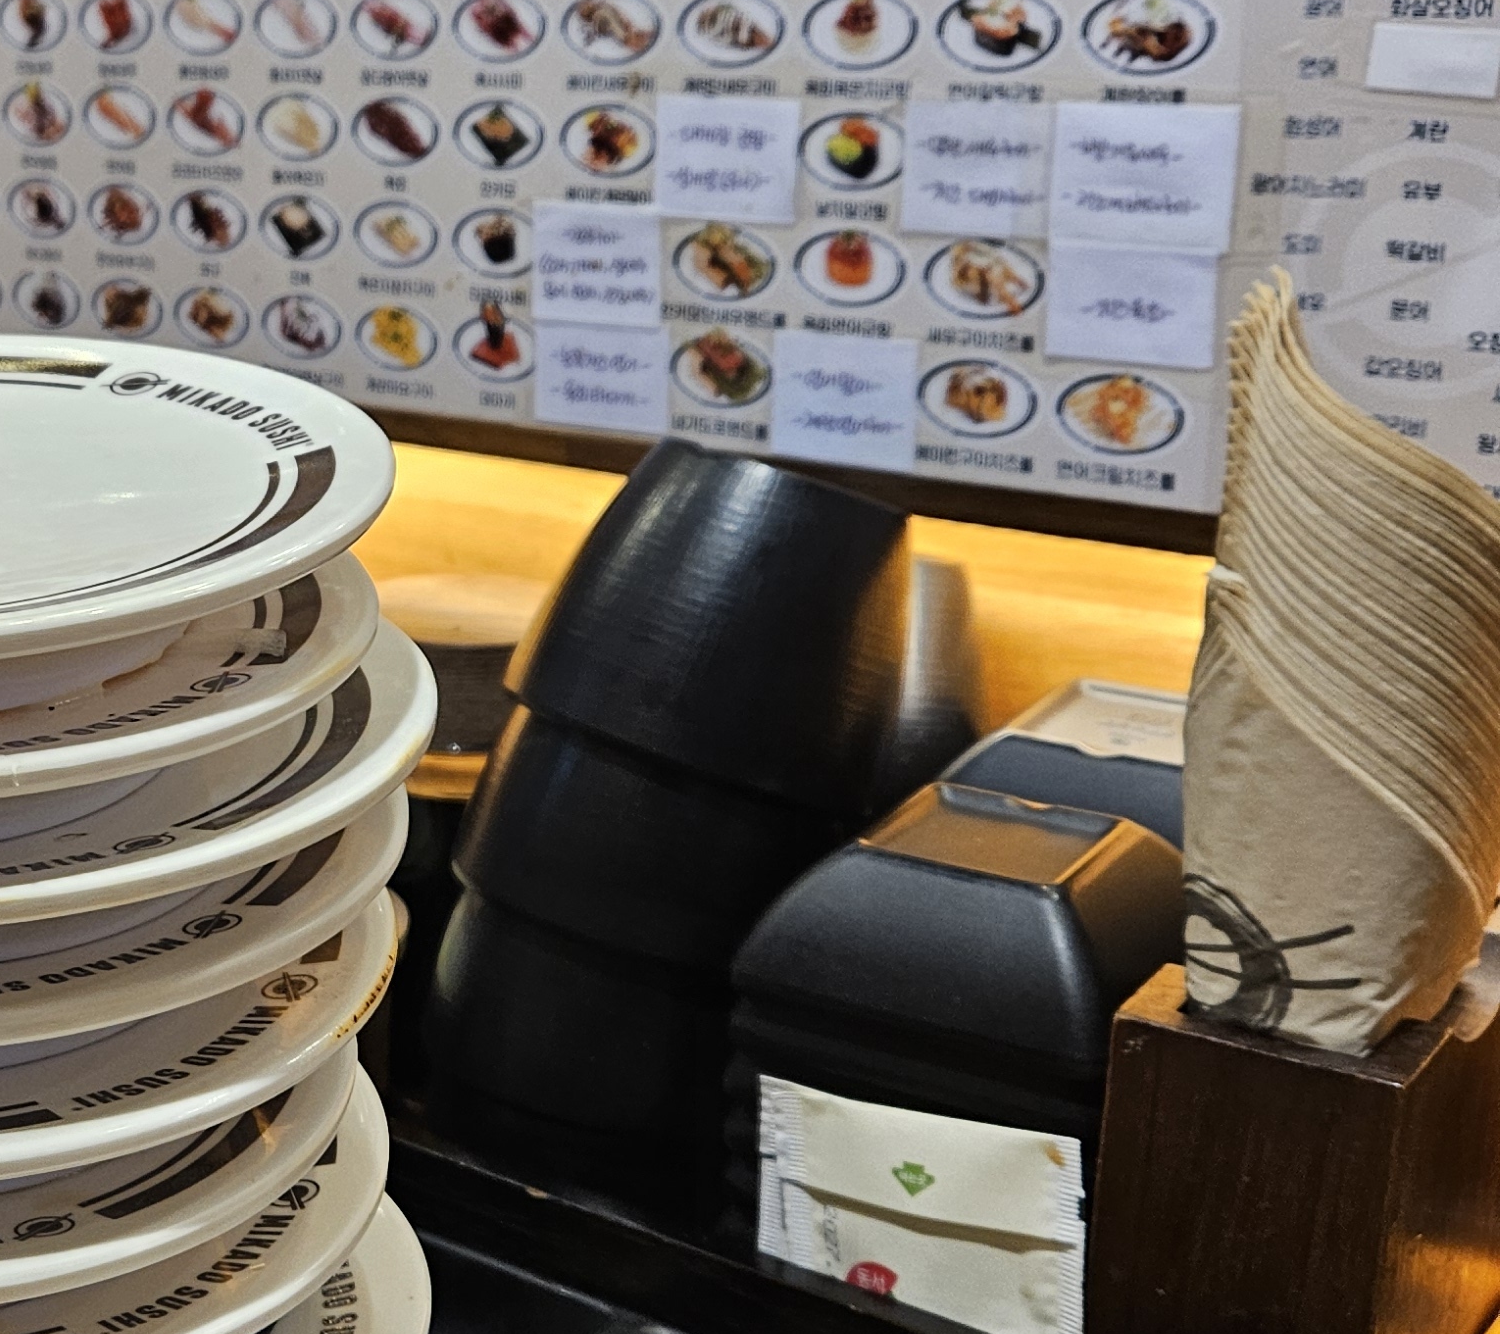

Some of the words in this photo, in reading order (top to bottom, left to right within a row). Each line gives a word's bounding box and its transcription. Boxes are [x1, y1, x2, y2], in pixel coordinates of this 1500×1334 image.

[156, 383, 261, 421] MIKADO
[248, 414, 306, 451] SUSHI
[39, 937, 188, 985] MIKADO
[181, 1005, 288, 1067] MIKADO
[75, 1068, 190, 1110] SUSHI
[197, 1207, 296, 1285] MIKADO
[106, 1280, 208, 1334] SUSHI
